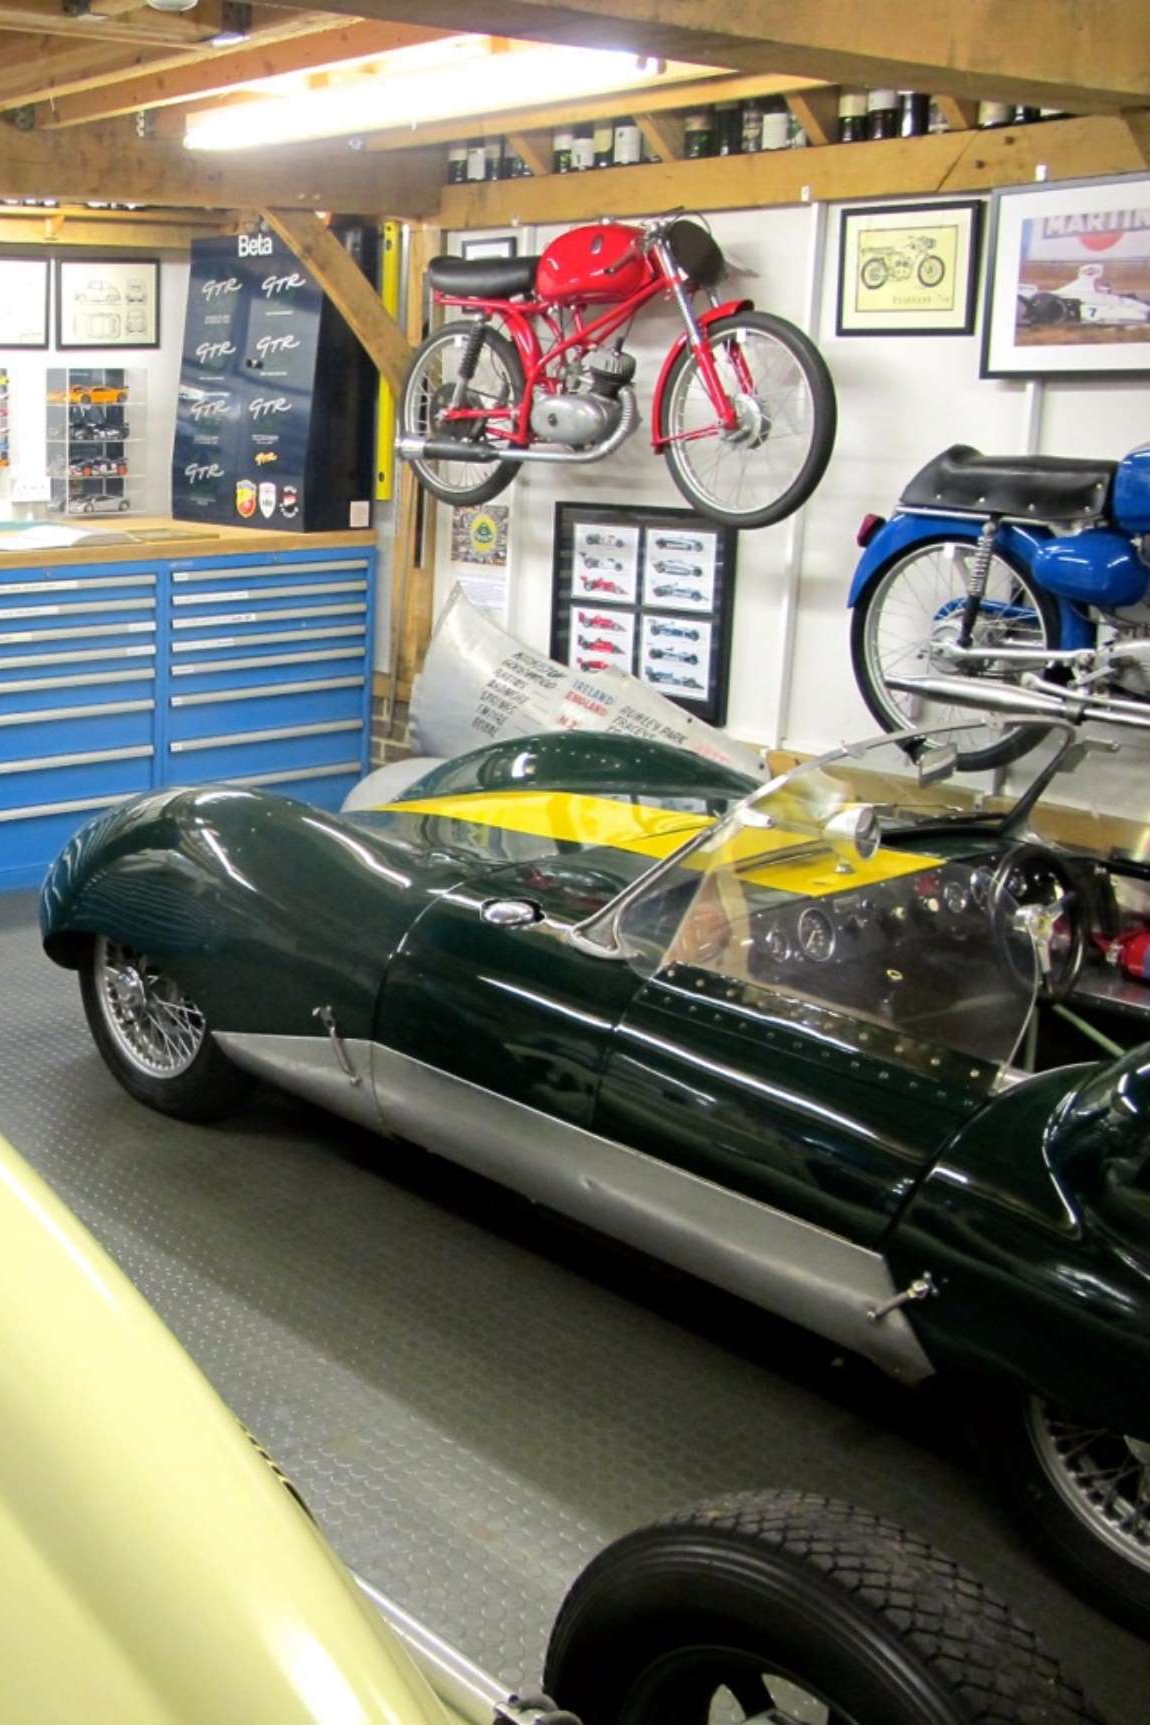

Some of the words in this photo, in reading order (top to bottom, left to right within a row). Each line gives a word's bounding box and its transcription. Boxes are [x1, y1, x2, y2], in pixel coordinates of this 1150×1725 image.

[237, 233, 273, 257] Beta
[202, 277, 242, 301] GTR
[261, 273, 306, 299] GTR
[1088, 307, 1097, 317] 7
[195, 341, 236, 364] GTR
[256, 335, 301, 359] GTR
[248, 397, 292, 420] GTR
[184, 463, 225, 484] GTR
[564, 691, 608, 717] ENGLAND
[572, 679, 616, 706] IRELAND
